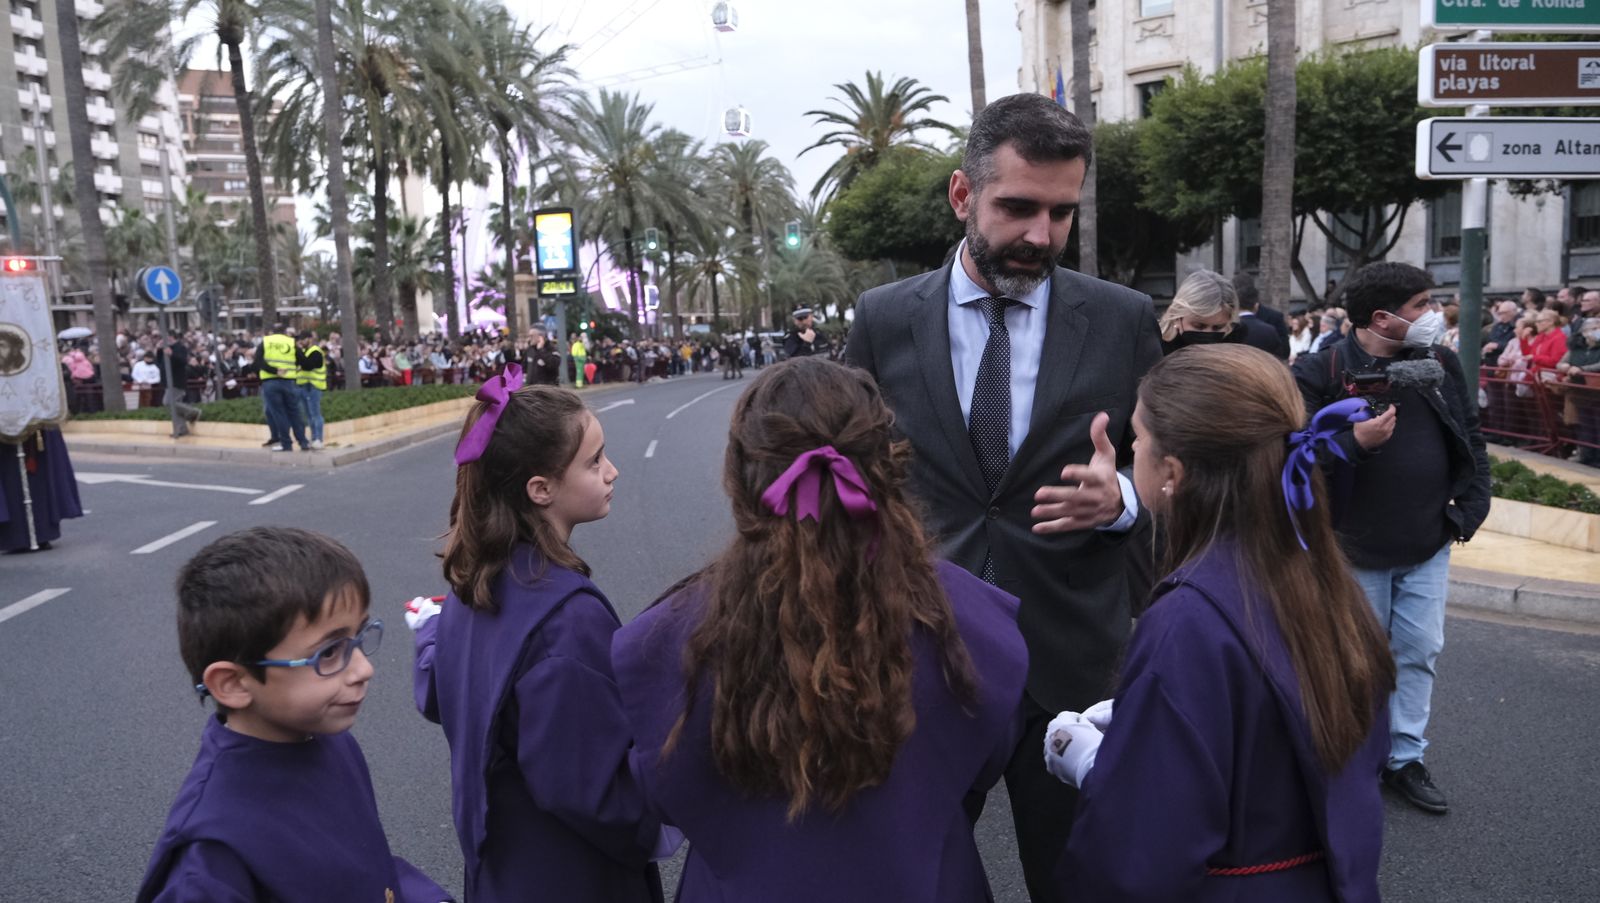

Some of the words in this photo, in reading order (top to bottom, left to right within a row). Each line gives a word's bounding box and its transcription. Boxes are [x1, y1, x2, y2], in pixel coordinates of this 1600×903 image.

[1479, 54, 1536, 71] litoral
[1438, 73, 1500, 94] playas
[1502, 143, 1542, 156] zona
